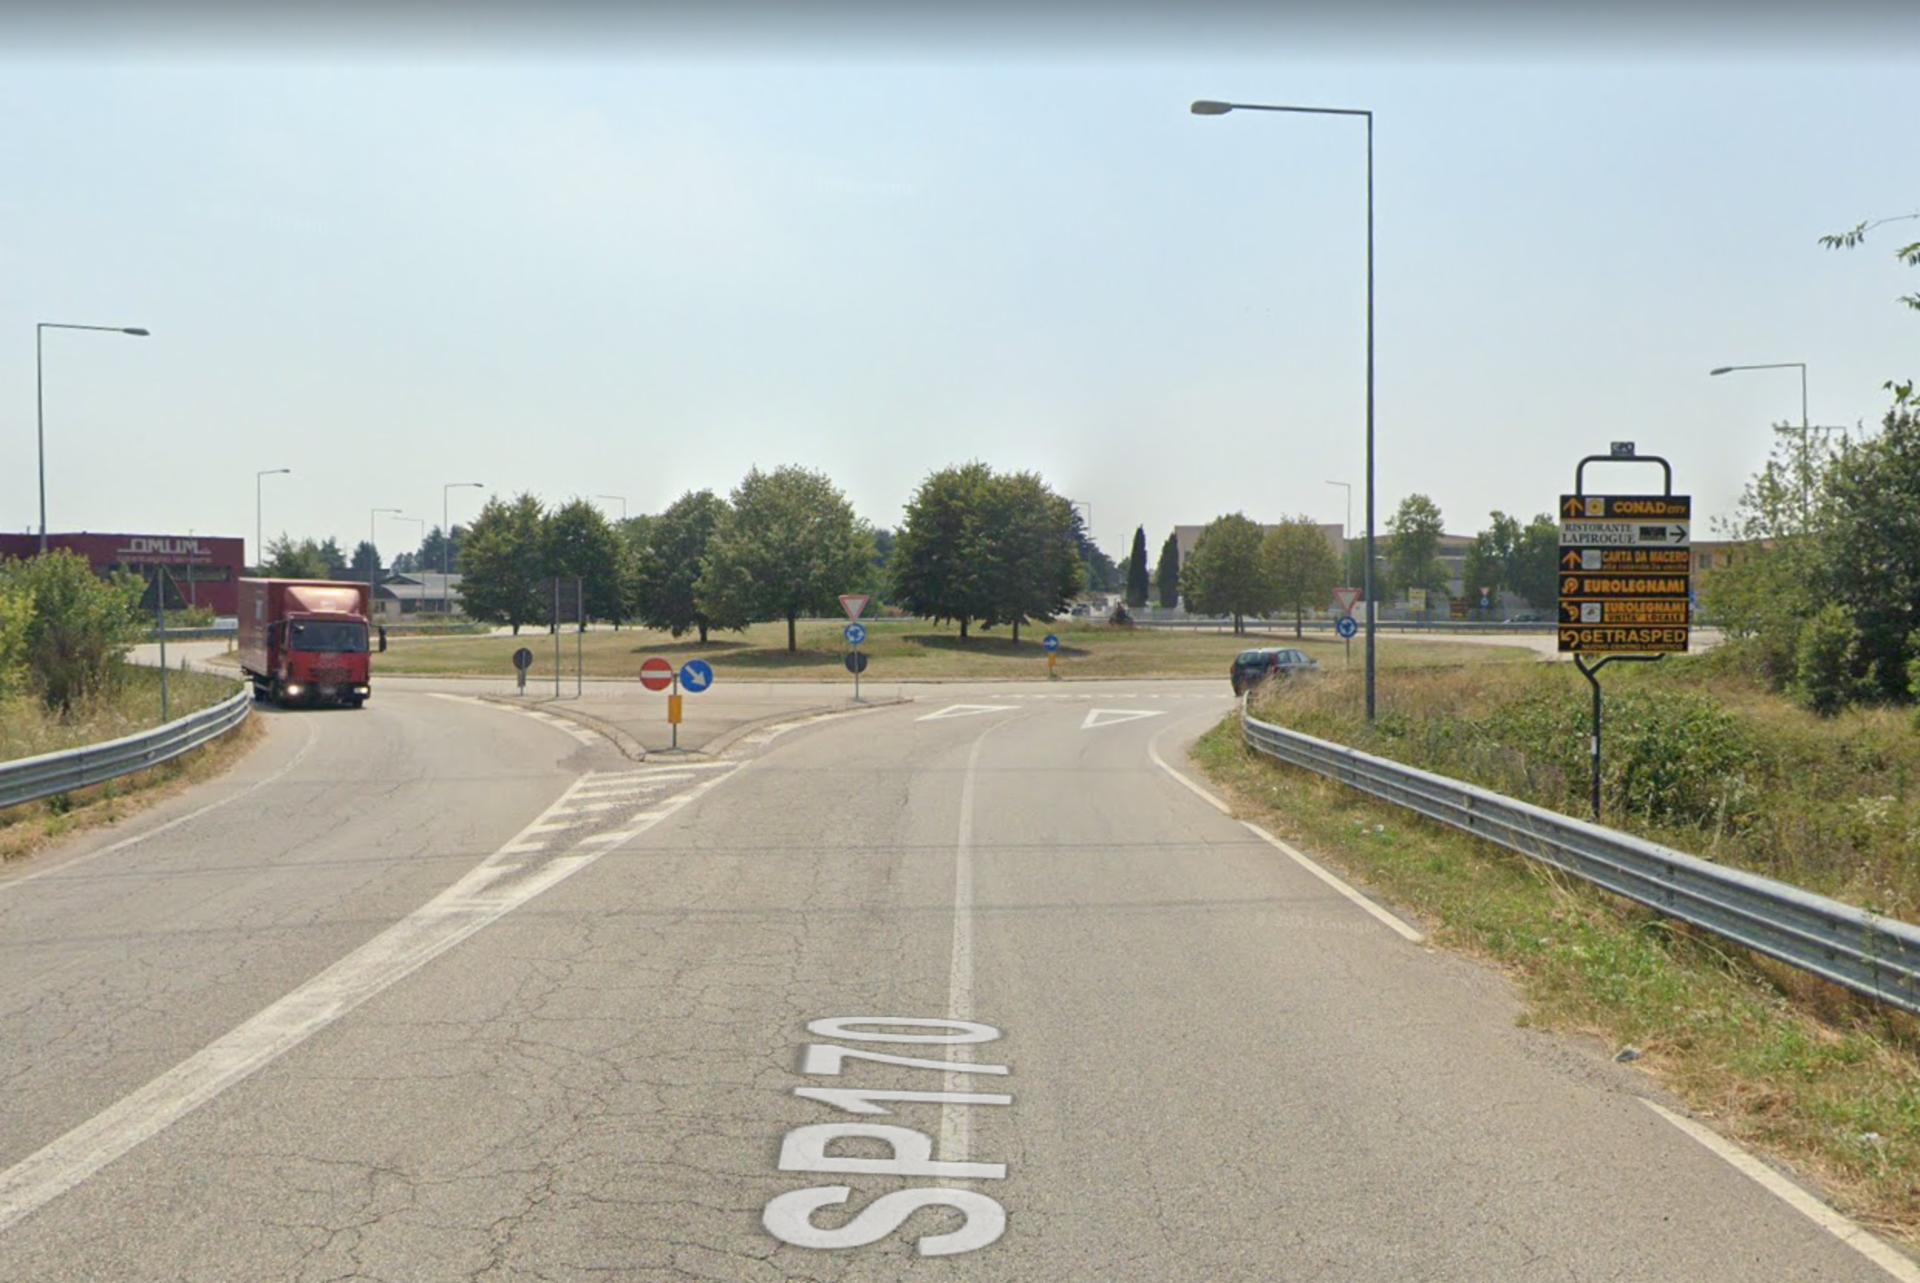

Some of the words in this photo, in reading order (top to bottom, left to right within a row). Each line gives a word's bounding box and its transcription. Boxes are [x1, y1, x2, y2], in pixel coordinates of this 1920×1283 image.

[1613, 501, 1666, 514] CONAD
[1564, 523, 1633, 533] RISTORANTE
[1562, 533, 1636, 545] LAPIROGUE
[1583, 579, 1686, 593] EUROLEGNAMI
[1603, 602, 1686, 612] EUROLEGNAMI
[1580, 629, 1686, 643] GETRASPED
[763, 1016, 1012, 1257] SP170
